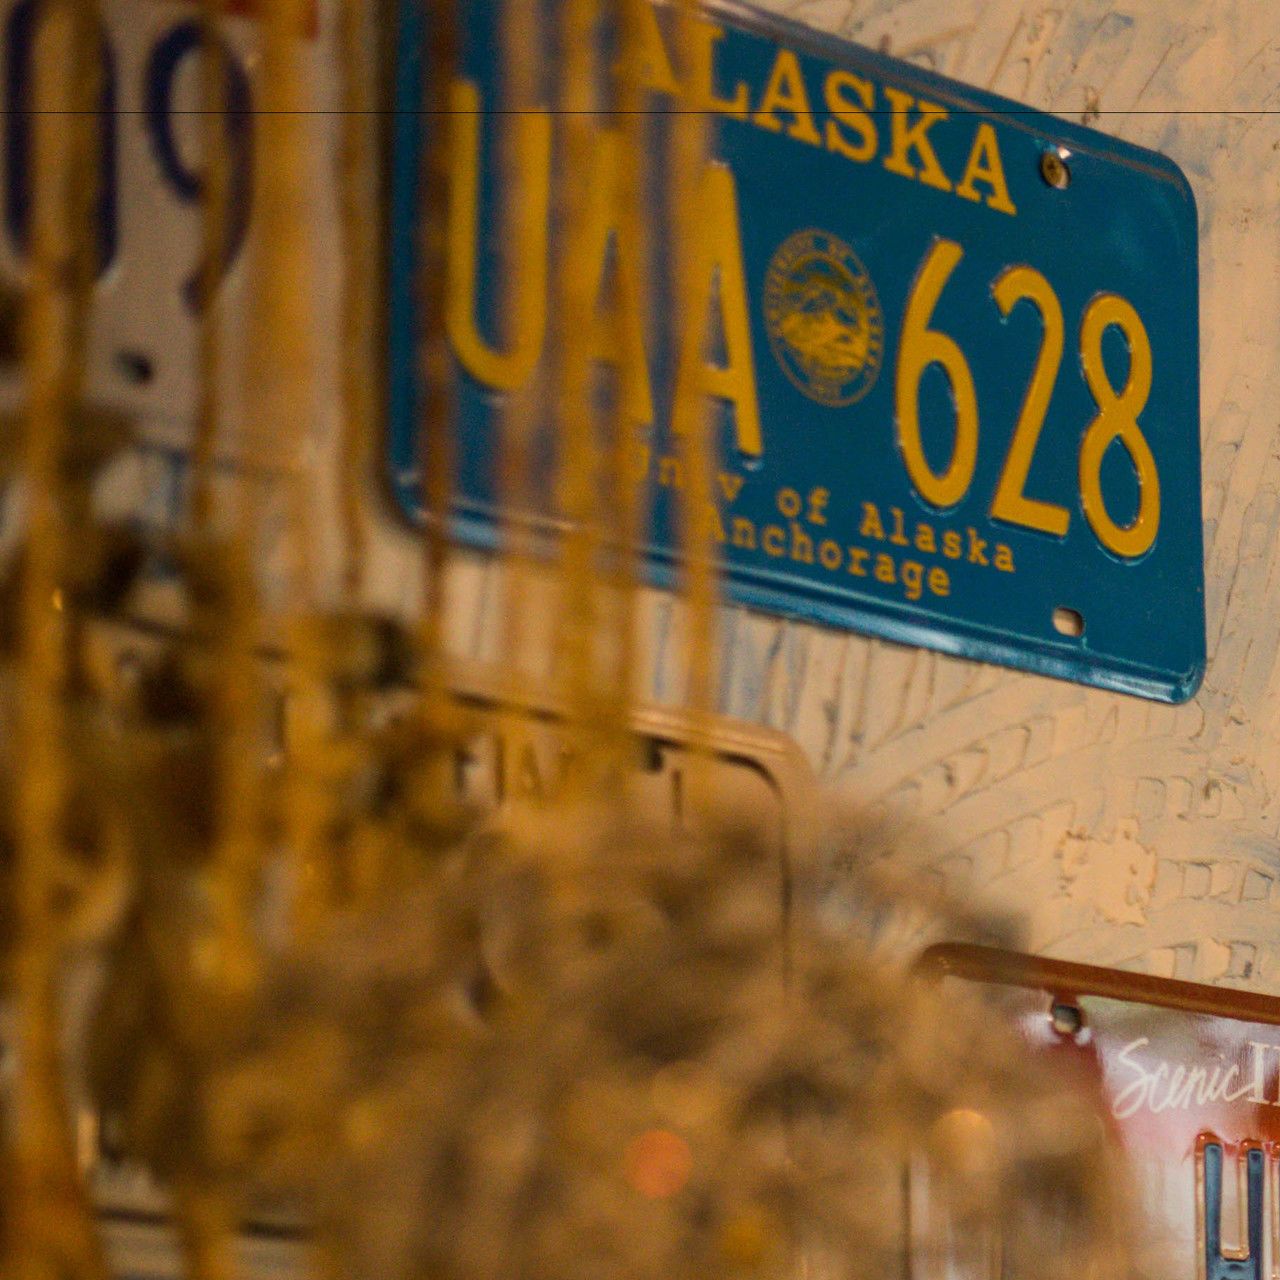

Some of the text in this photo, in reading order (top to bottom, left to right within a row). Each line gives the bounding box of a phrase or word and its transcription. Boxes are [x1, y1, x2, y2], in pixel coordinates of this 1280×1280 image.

[894, 236, 1162, 558] 628
[632, 443, 1016, 573] Unv of Alaska
[703, 501, 952, 602] Anchorage
[1113, 1036, 1256, 1119] Scenic
